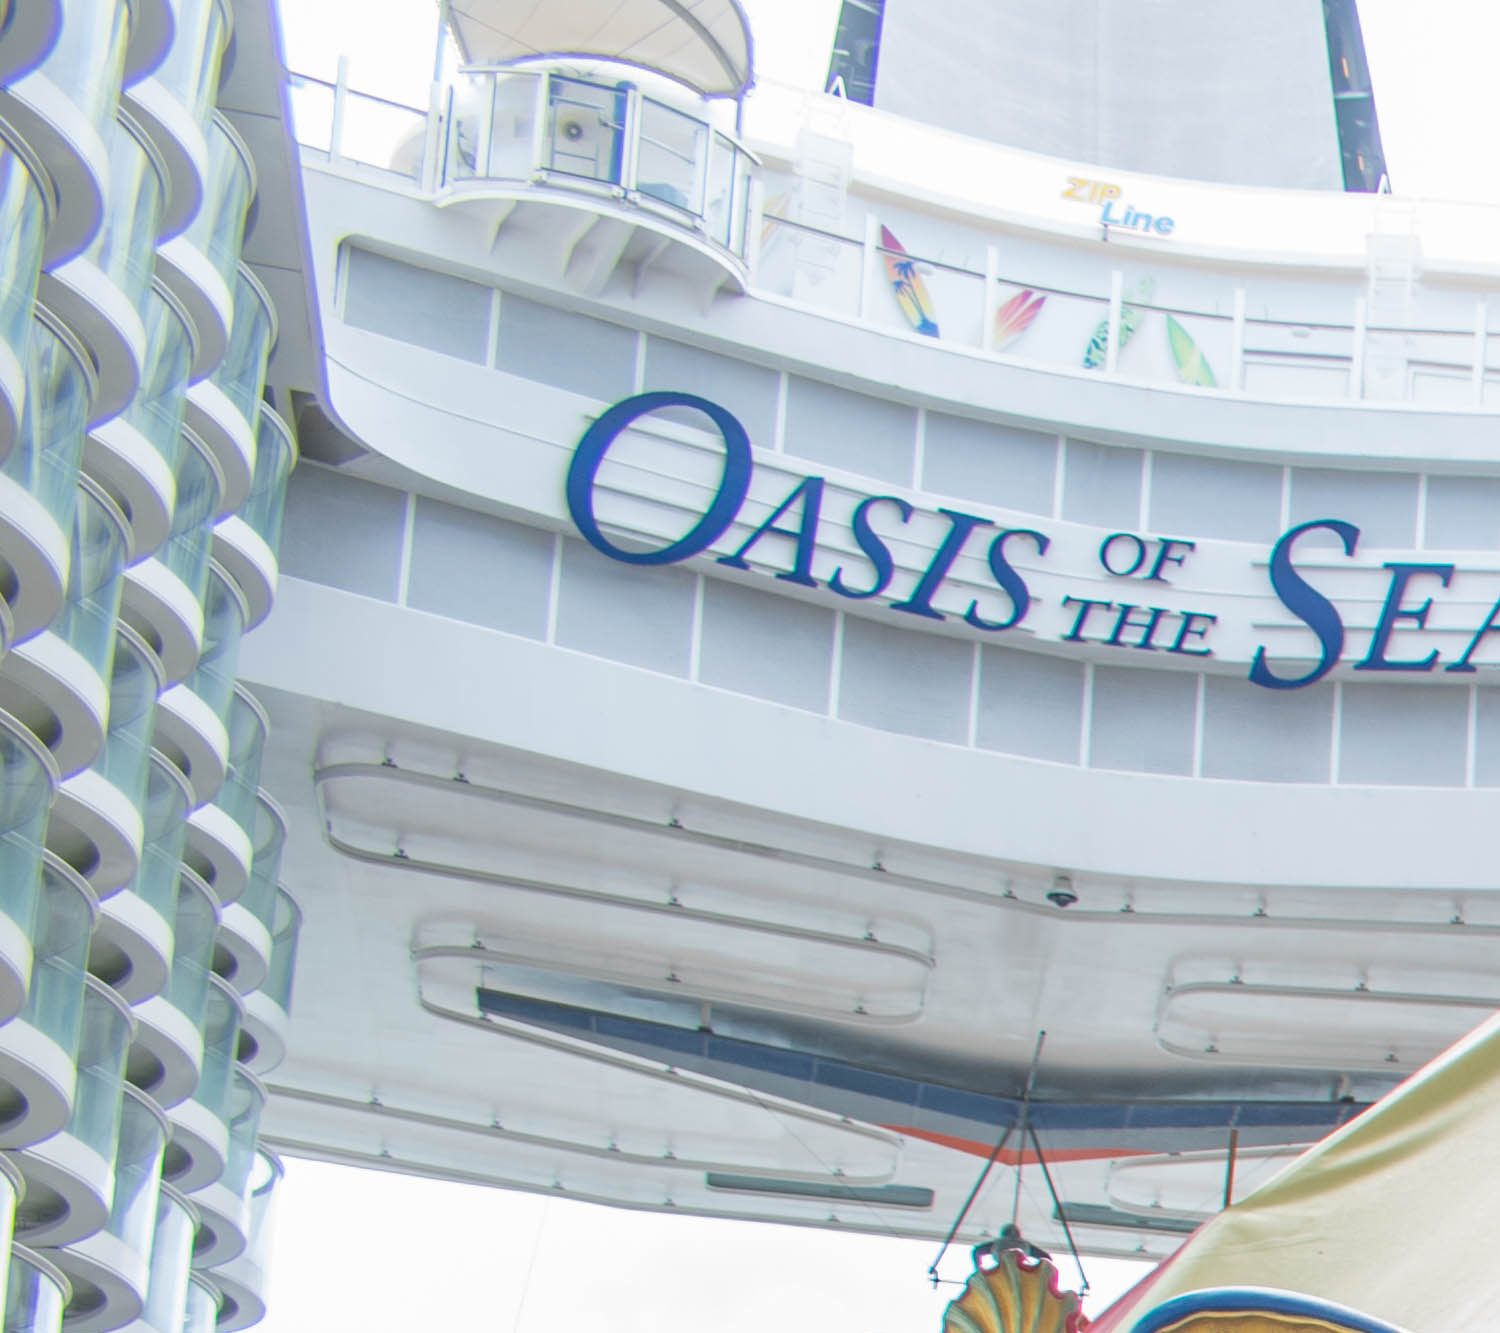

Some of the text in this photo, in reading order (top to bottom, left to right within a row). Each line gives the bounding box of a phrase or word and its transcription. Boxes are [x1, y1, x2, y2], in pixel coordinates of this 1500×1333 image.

[1062, 176, 1121, 206] ZIP
[1100, 200, 1175, 235] Line
[566, 390, 1051, 632] OASIS
[1098, 532, 1196, 584] OF
[1059, 594, 1219, 657] THE
